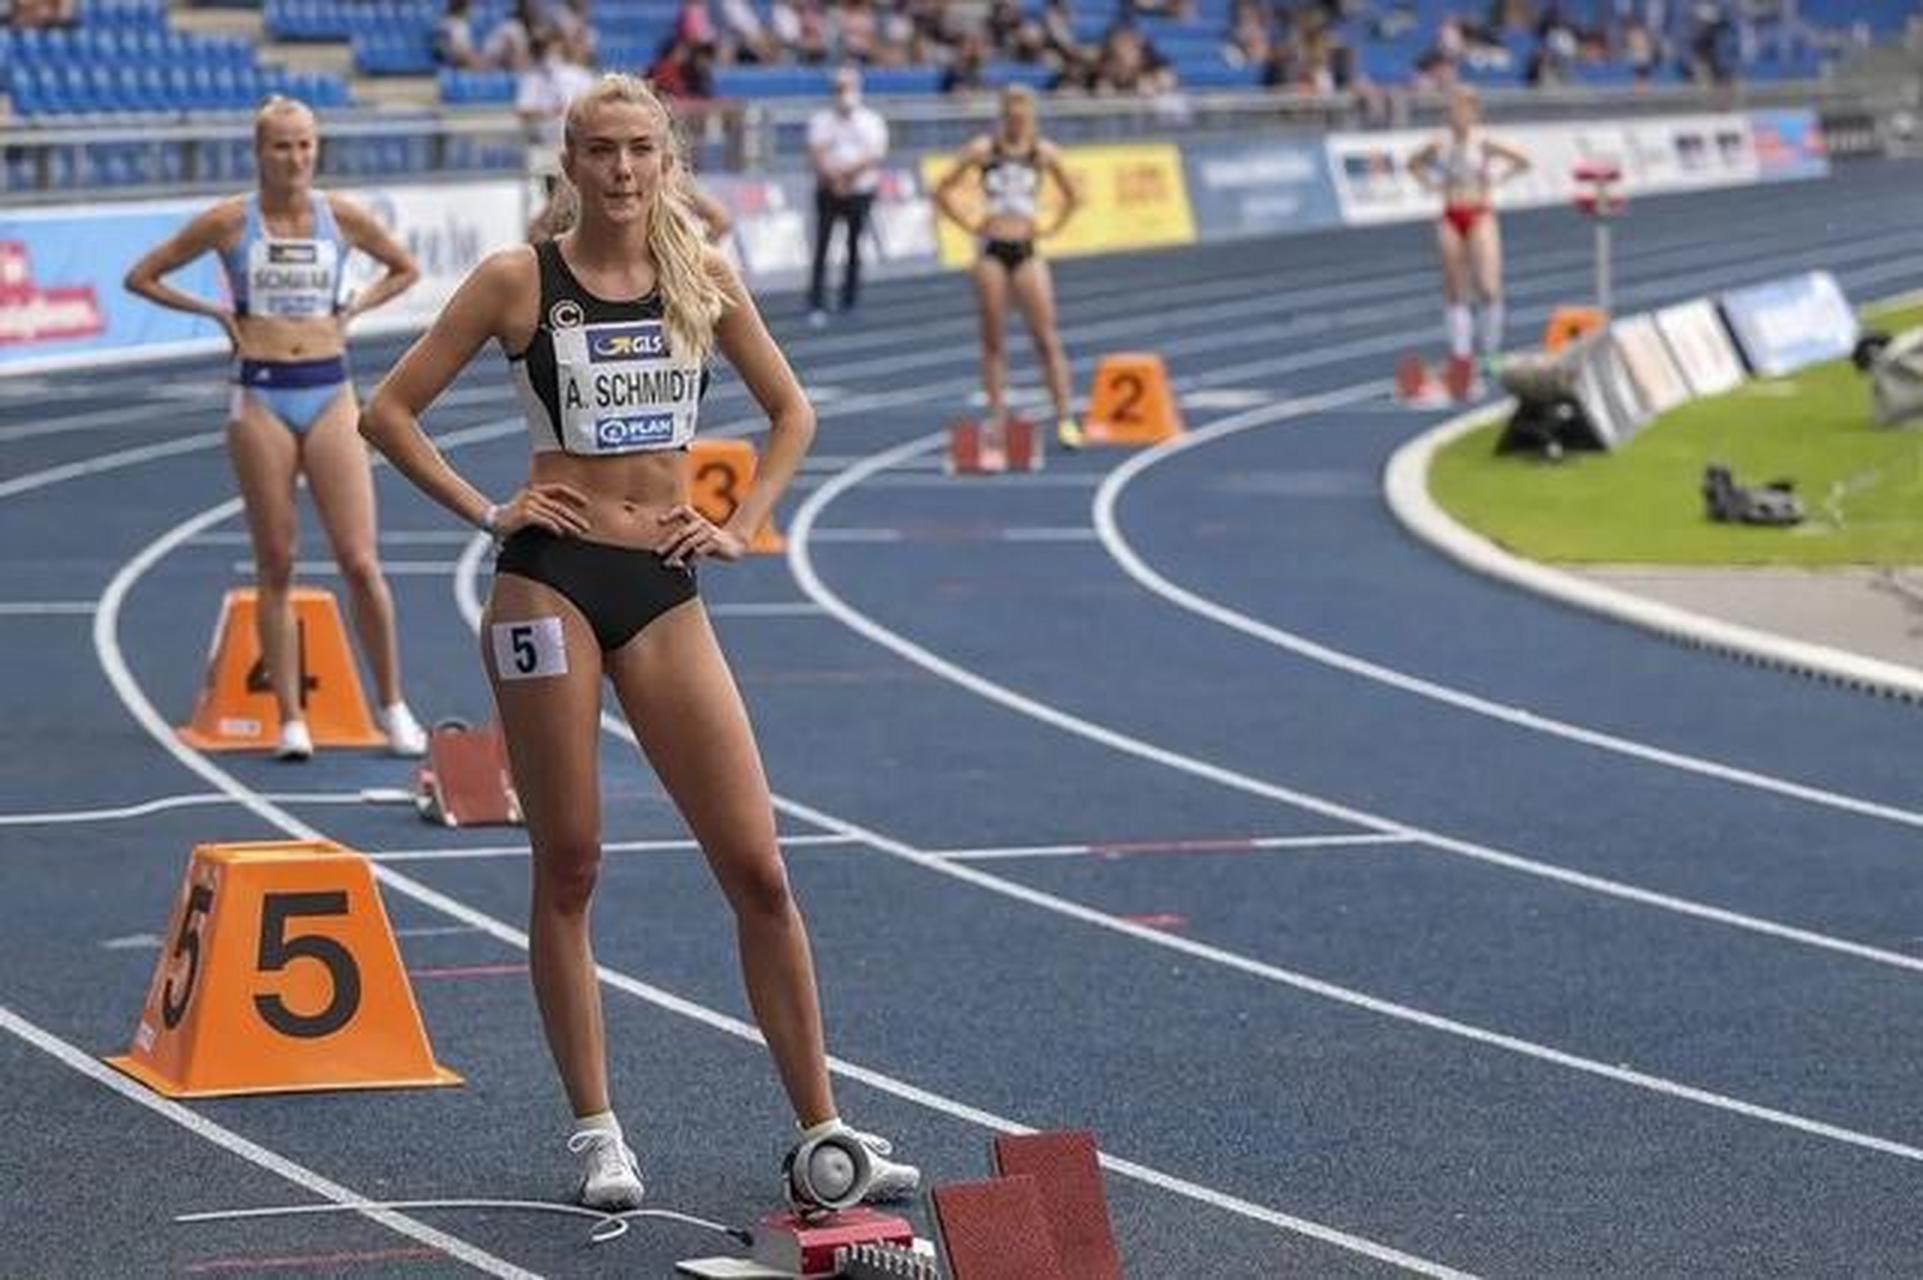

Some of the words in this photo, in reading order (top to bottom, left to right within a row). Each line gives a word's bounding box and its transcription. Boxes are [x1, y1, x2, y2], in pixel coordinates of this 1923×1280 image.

[632, 335, 664, 353] GLS
[565, 377, 590, 410] A.
[595, 368, 698, 408] SCHMIDT
[1109, 370, 1145, 424] 2
[694, 462, 739, 529] 3
[511, 626, 538, 674] 5
[162, 884, 214, 1030] 5
[253, 889, 362, 1038] 5
